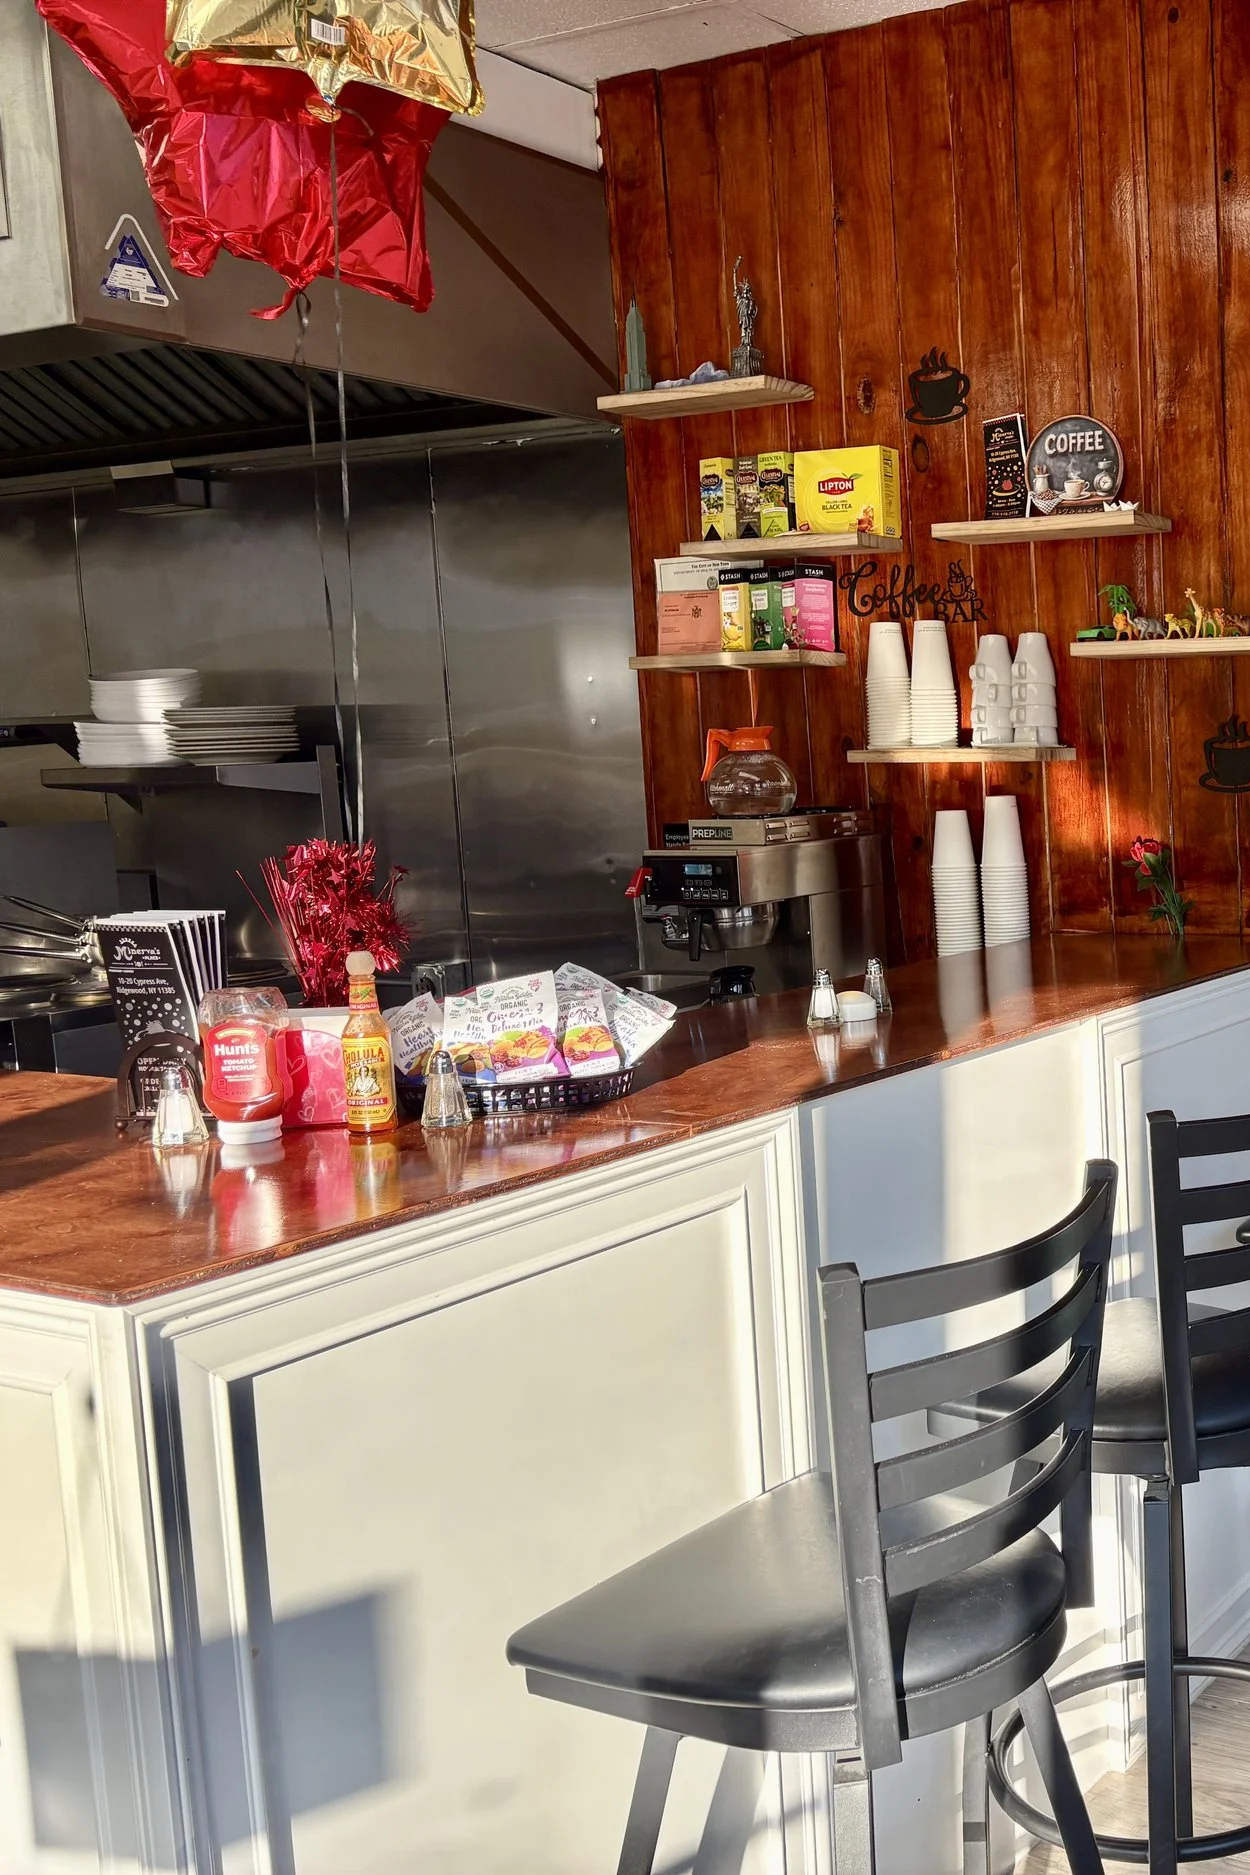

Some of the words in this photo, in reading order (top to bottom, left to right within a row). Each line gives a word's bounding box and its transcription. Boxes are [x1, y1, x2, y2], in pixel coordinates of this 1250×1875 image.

[1045, 430, 1104, 455] COFFEE
[820, 480, 853, 492] LIPTON
[754, 572, 769, 580] STASH
[839, 561, 947, 620] Coffee
[933, 599, 989, 624] BAR
[692, 829, 733, 838] PREPLINE
[113, 945, 161, 961] Minerva's
[133, 977, 156, 986] Cypress
[500, 999, 528, 1010] ORGANIC
[559, 1000, 586, 1012] ORGANIC
[400, 1020, 426, 1037] ORGANIC
[343, 1047, 384, 1066] CHOLULA
